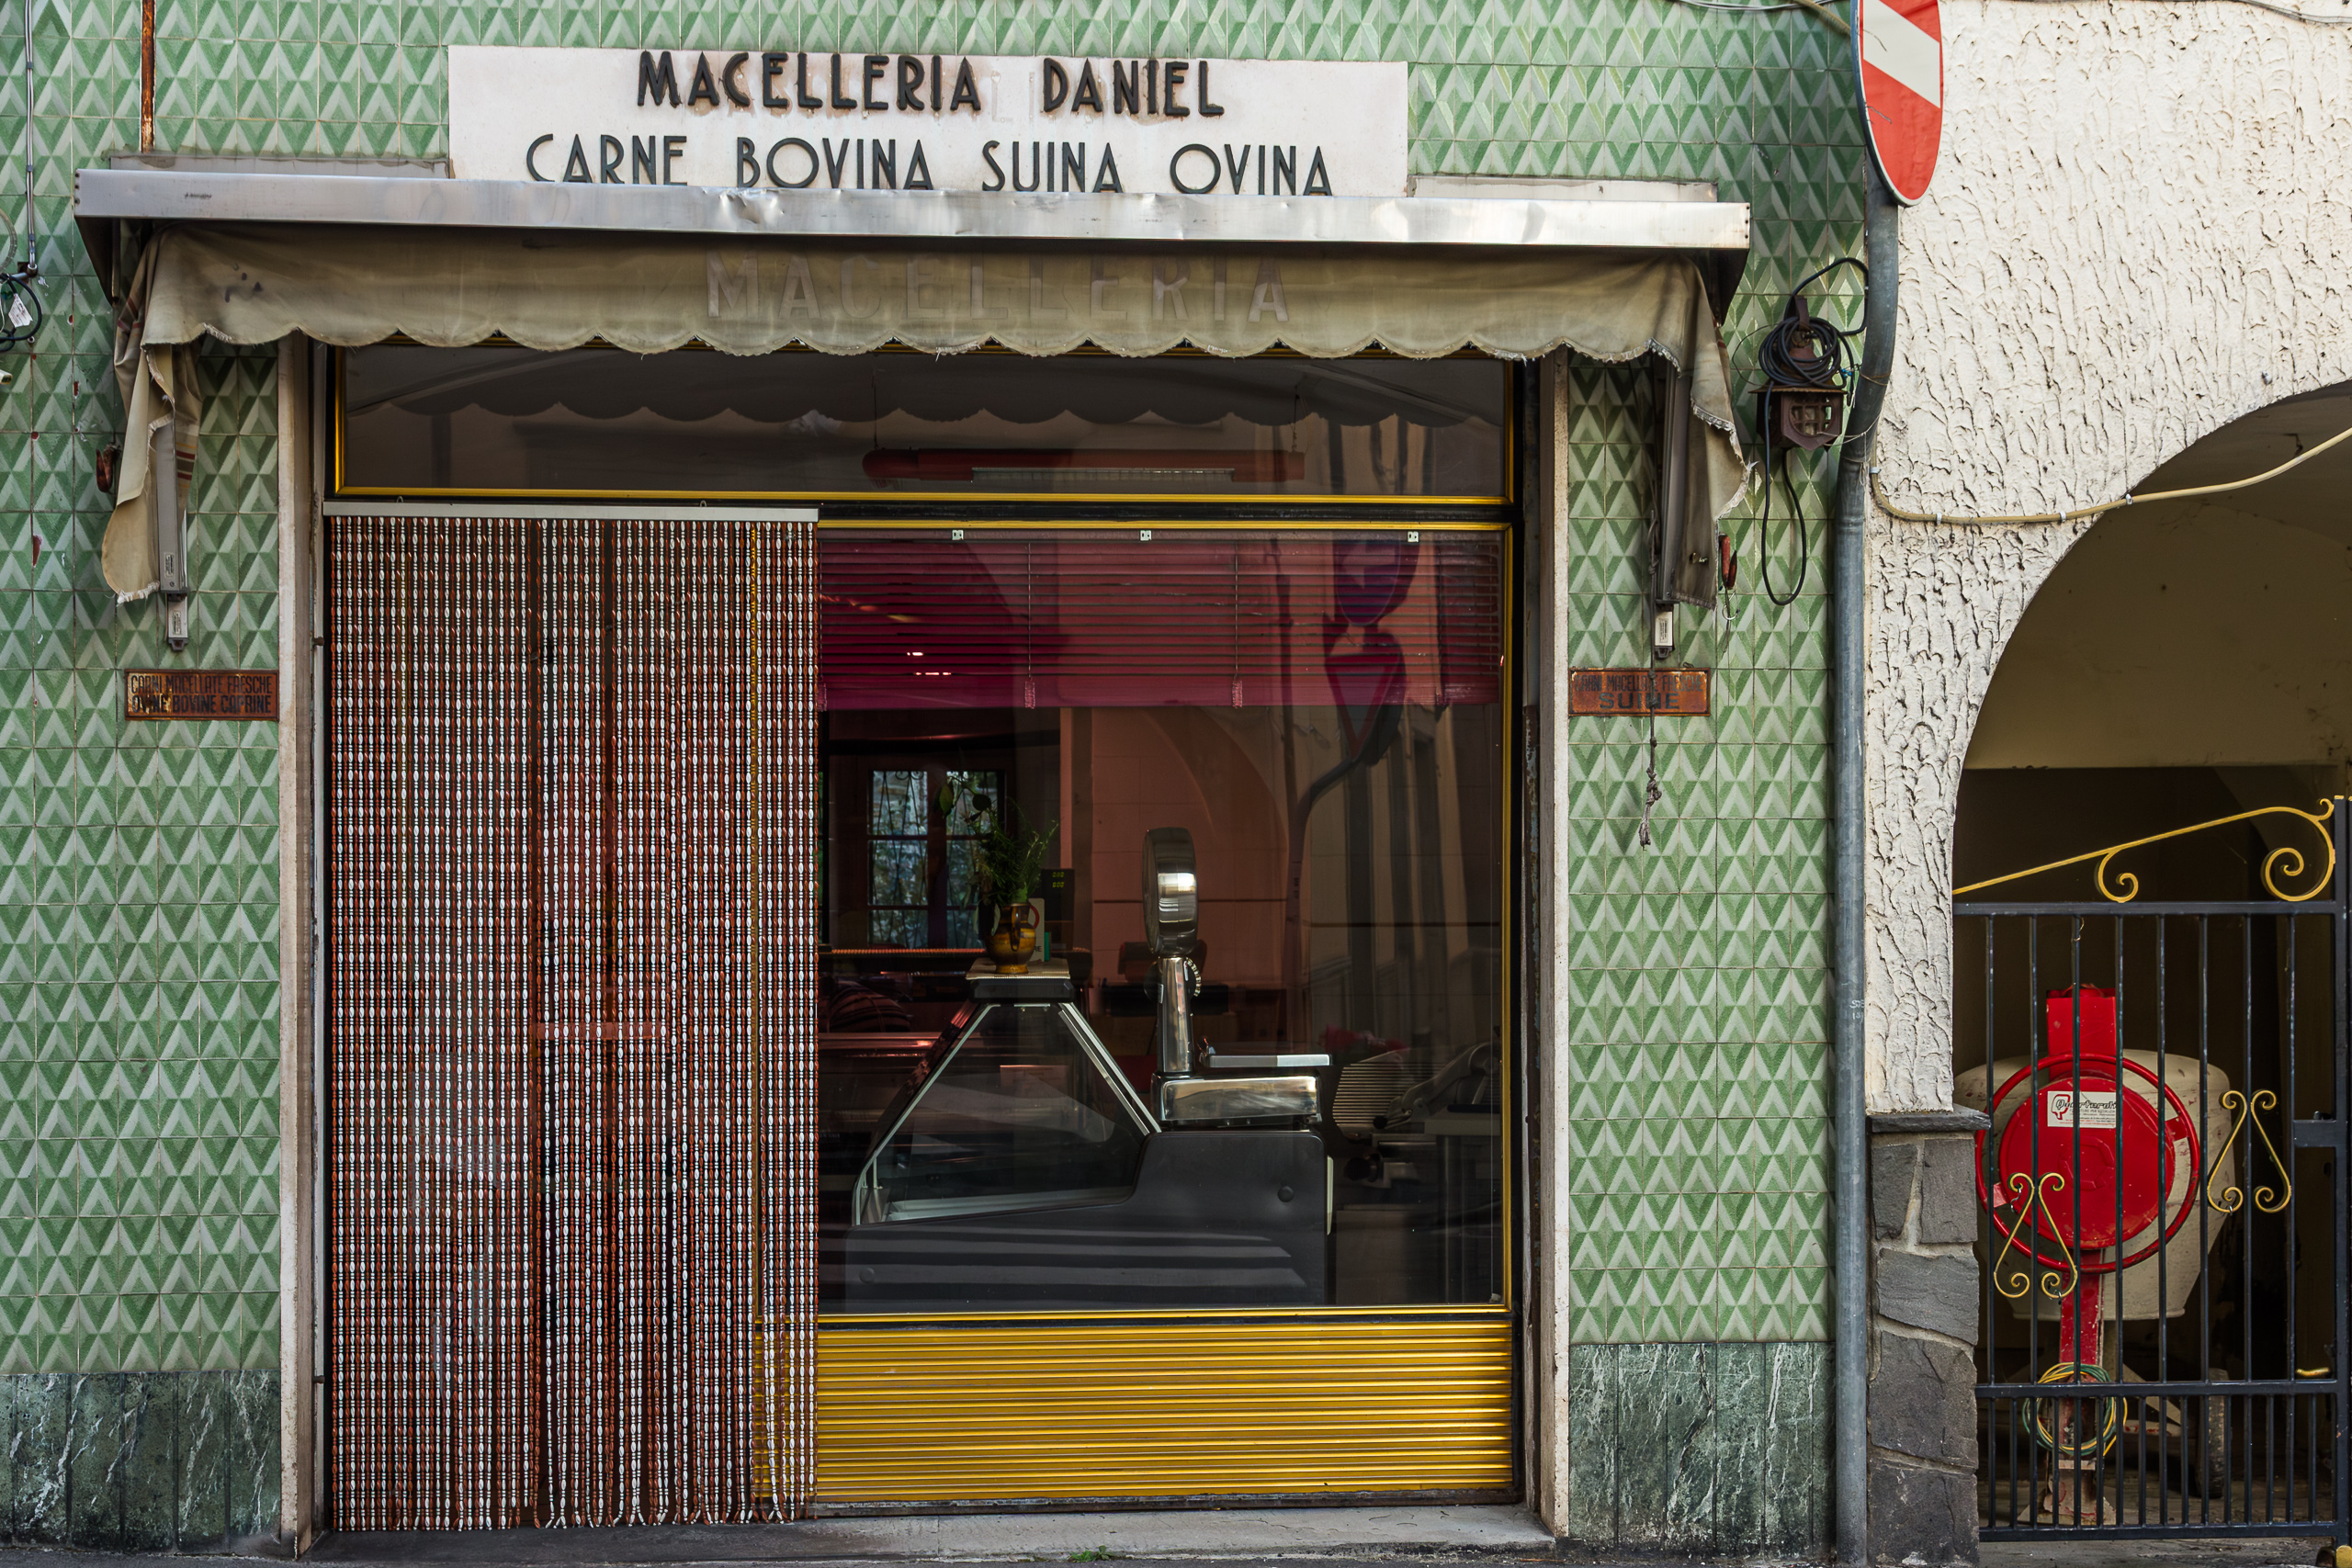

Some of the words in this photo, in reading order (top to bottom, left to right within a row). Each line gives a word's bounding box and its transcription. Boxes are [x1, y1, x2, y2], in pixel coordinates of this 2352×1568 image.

[637, 51, 982, 111] MACELLERIA
[1043, 57, 1225, 118] DANIEL
[526, 134, 688, 185] CARNE
[737, 136, 935, 189] BOVINA
[981, 140, 1124, 193] SUINA
[1170, 143, 1333, 196] OVINA
[706, 253, 1290, 323] MACELLERIA
[130, 675, 163, 694] CARNI
[165, 675, 223, 694] MACELLATE
[227, 675, 273, 694] FRESCHE
[1608, 674, 1658, 692] MACELLAE
[172, 695, 217, 713] BOVINE
[220, 695, 271, 713] CAPRINE
